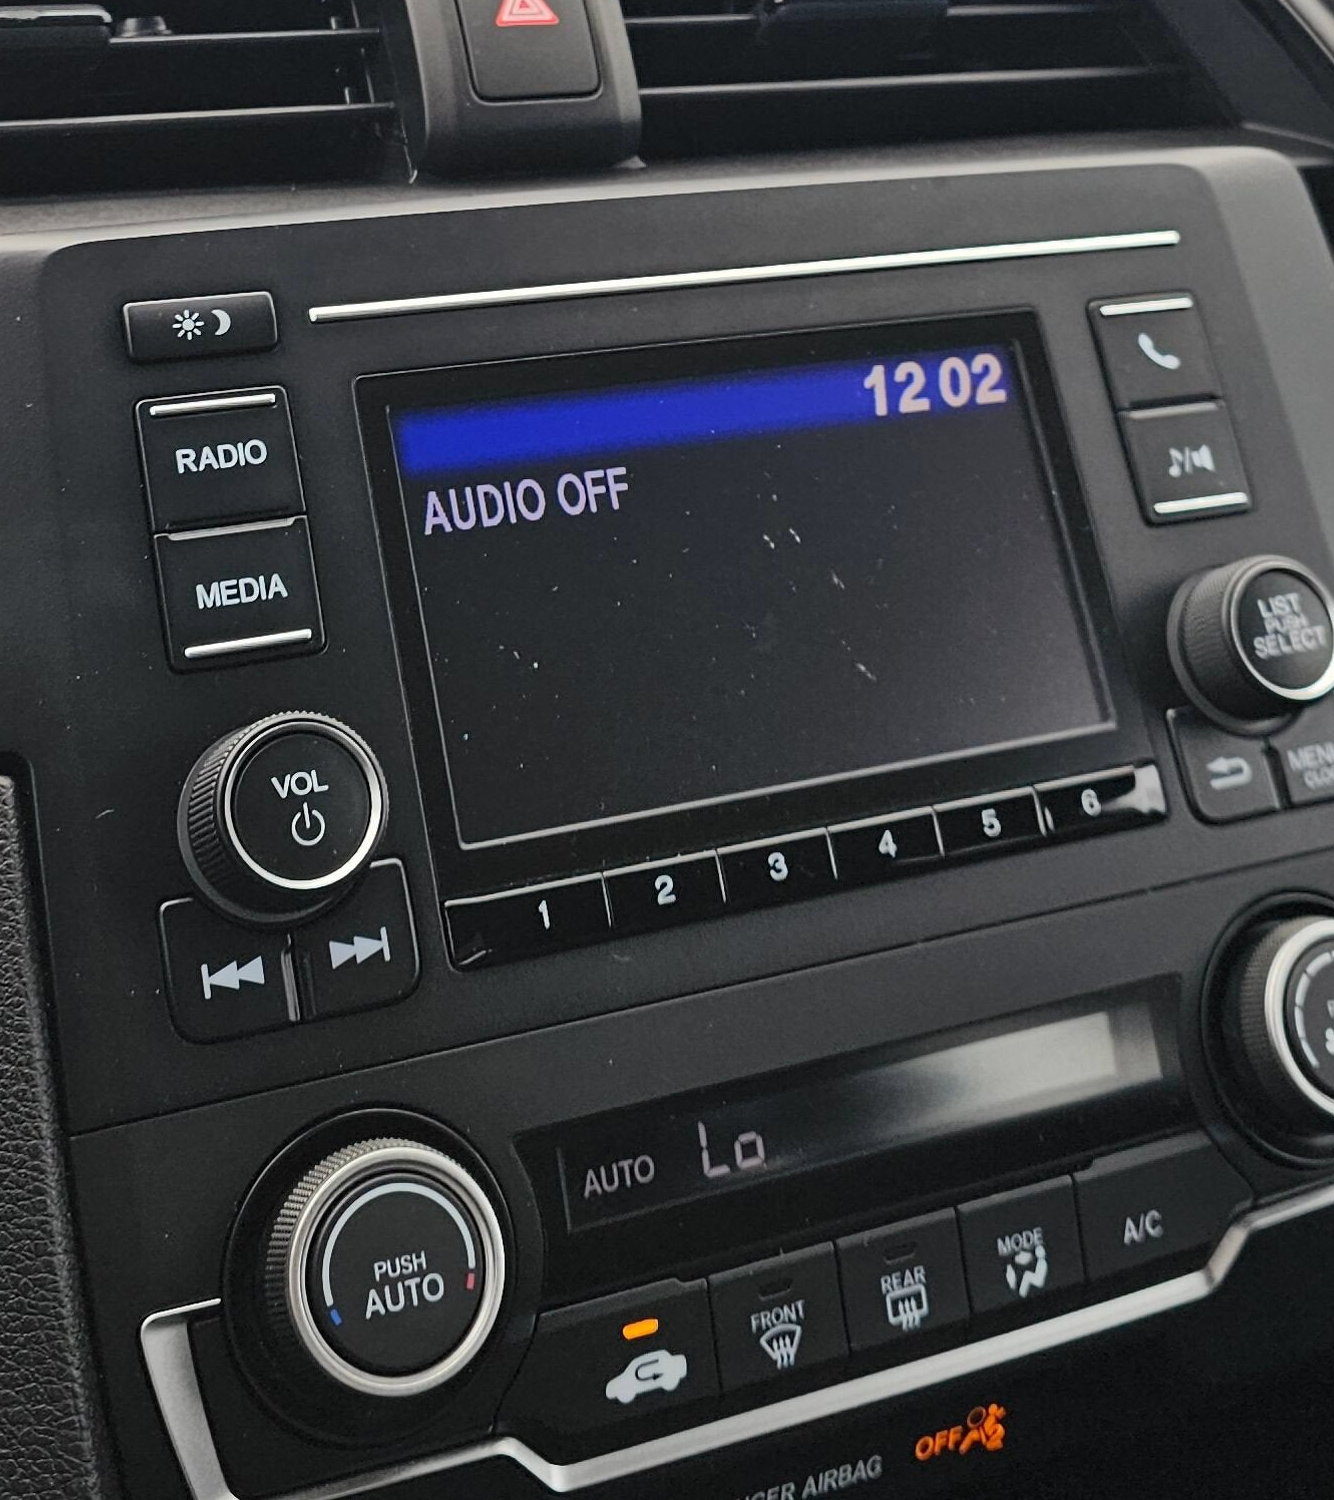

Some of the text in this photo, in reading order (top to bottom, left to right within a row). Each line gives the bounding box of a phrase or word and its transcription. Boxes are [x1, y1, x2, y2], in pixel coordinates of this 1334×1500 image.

[174, 439, 268, 475] RADIO
[423, 466, 630, 536] AUDIO OFF
[195, 572, 289, 611] MEDIA
[1256, 592, 1301, 619] LIST
[1252, 624, 1326, 660] SELECT
[271, 769, 329, 800] VOL
[538, 788, 1102, 930] 1 2 3 4 5 6
[583, 1120, 766, 1200] AUTO Lo
[996, 1226, 1044, 1257] MODE
[1123, 1209, 1164, 1246] A/C
[373, 1250, 427, 1282] PUSH
[880, 1265, 927, 1295] REAR
[365, 1272, 445, 1320] AUTO
[750, 1299, 805, 1334] FRONT
[914, 1425, 964, 1461] OFF
[802, 1454, 883, 1500] AIRBAG
